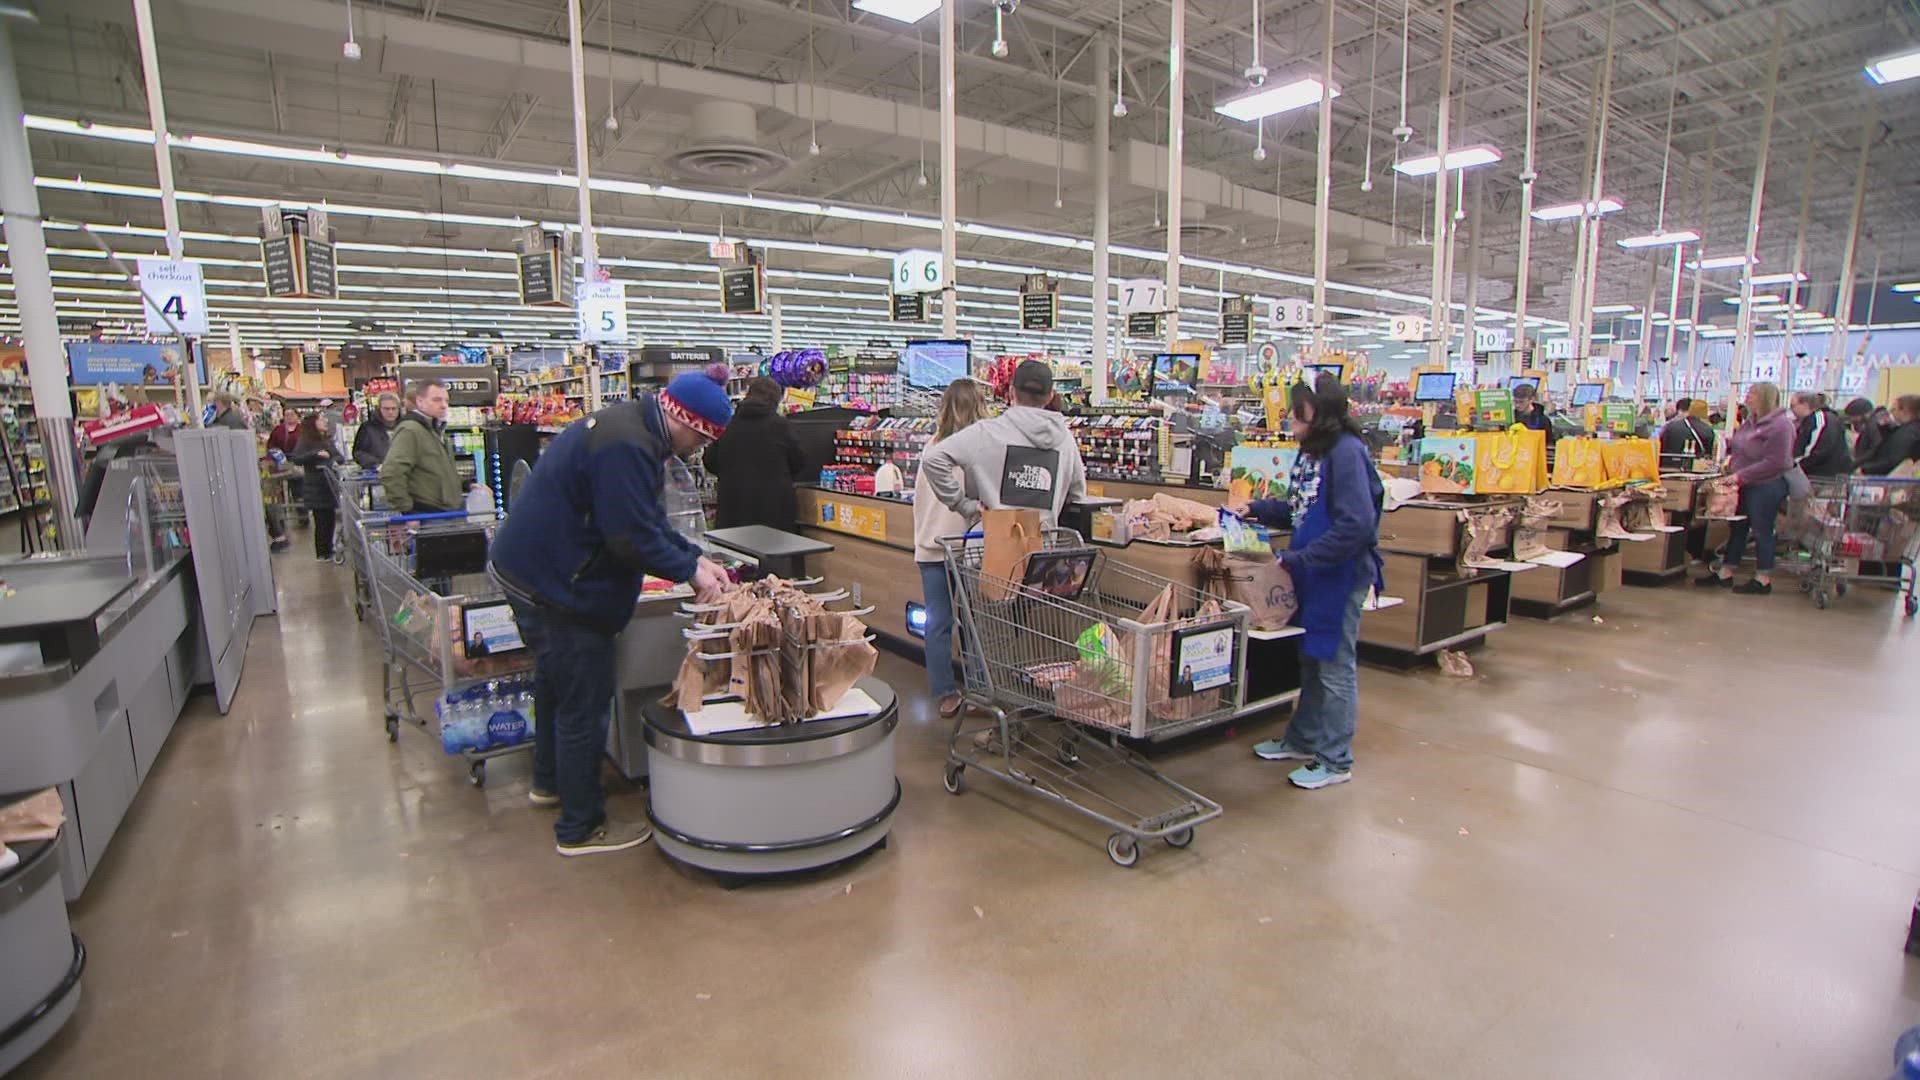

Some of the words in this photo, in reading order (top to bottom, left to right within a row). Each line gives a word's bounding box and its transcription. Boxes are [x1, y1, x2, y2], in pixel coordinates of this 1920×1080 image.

[313, 215, 325, 236] 12
[527, 230, 541, 249] 13
[159, 263, 176, 273] self
[900, 260, 909, 283] 6
[924, 260, 938, 283] 6
[147, 271, 192, 282] checkout
[1031, 276, 1044, 290] 16
[1125, 288, 1135, 307] 7
[1146, 287, 1159, 306] 7
[162, 295, 188, 320] 4
[1275, 306, 1286, 322] 8
[1296, 304, 1303, 321] 8
[601, 310, 616, 332] 5
[1396, 321, 1406, 335] 9
[1479, 333, 1496, 347] 10
[670, 352, 711, 361] BATTERIES
[1754, 366, 1774, 378] 14
[453, 382, 464, 390] TO
[466, 382, 479, 390] GO
[1008, 471, 1040, 483] NORTH
[1023, 464, 1041, 476] THE
[1015, 478, 1041, 490] FACE
[488, 720, 526, 733] WATER
